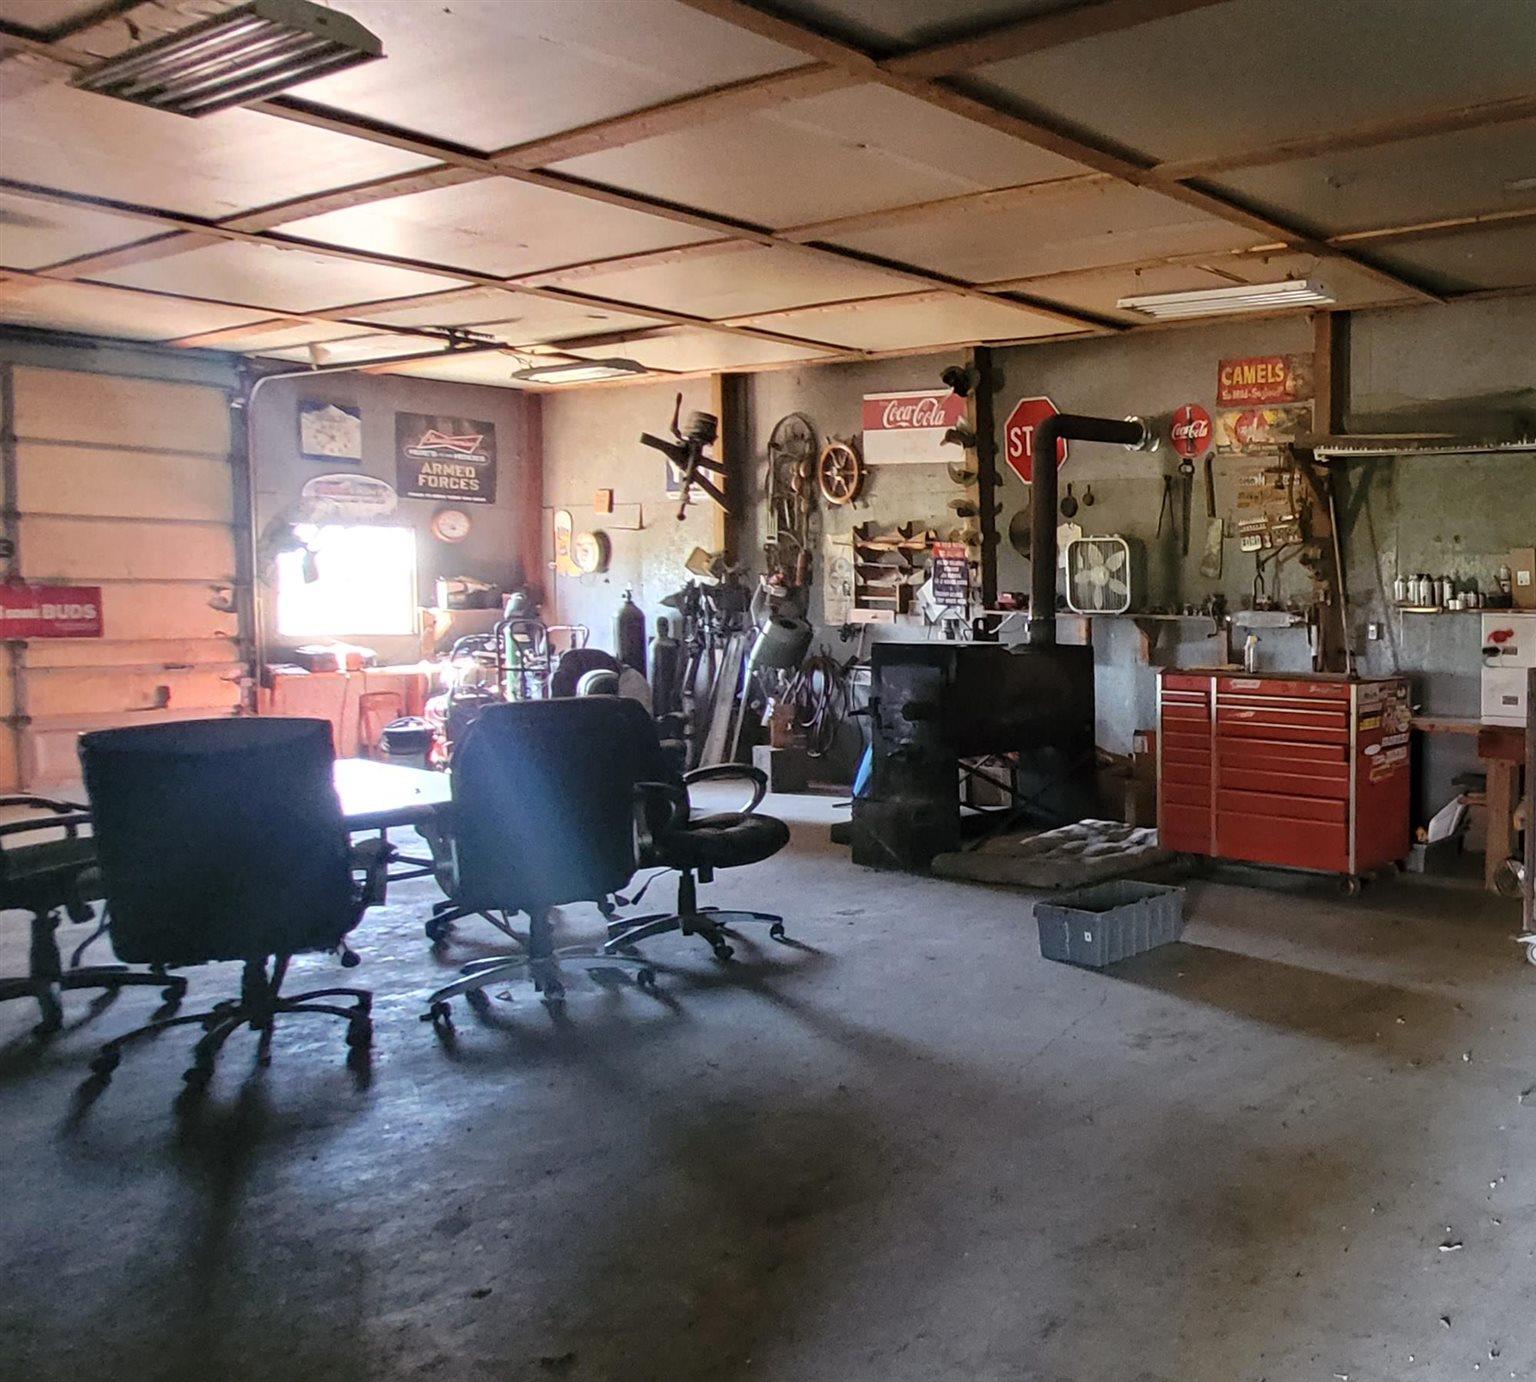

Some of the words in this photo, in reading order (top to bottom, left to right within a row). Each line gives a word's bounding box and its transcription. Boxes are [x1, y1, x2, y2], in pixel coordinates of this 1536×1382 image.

[1221, 363, 1285, 385] CAMELS
[1010, 425, 1034, 458] ST
[421, 462, 476, 478] ARMED
[418, 474, 480, 491] FORCES
[41, 603, 97, 619] BUDS
